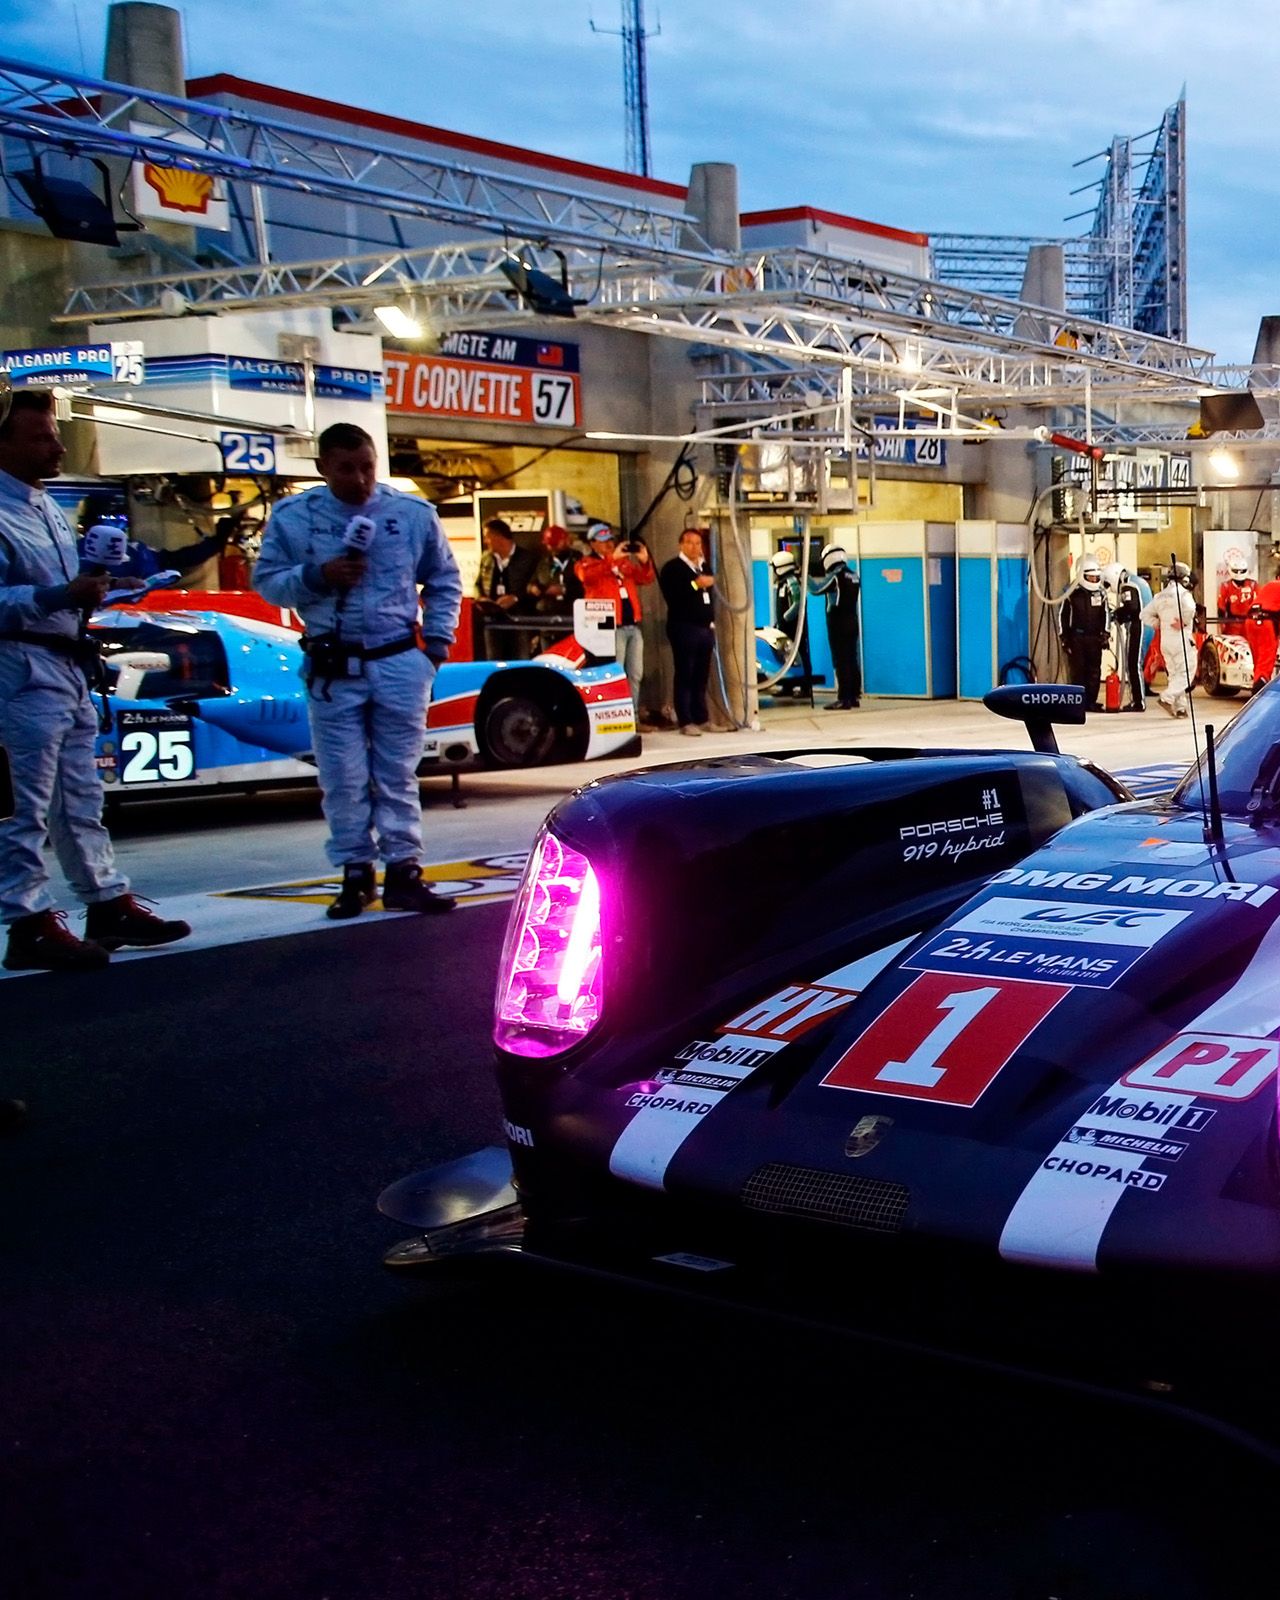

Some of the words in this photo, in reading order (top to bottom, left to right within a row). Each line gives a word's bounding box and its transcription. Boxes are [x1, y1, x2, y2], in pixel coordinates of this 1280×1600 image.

[8, 352, 72, 369] ALGARVE
[77, 349, 110, 364] PRO
[443, 333, 489, 358] MGTE
[491, 338, 517, 361] AM
[27, 375, 60, 385] RACING
[63, 373, 89, 383] TEAM
[115, 355, 143, 385] 25
[331, 370, 369, 384] PRO
[413, 364, 523, 416] CORVETTE
[536, 379, 571, 419] 57
[222, 433, 275, 472] 25
[1021, 693, 1083, 705] CHOPARD
[594, 709, 632, 720] NISSAN
[121, 730, 194, 783] 25
[982, 788, 1001, 810] #1
[900, 813, 1004, 840] PORSCHE
[903, 842, 938, 862] 919
[940, 831, 1005, 863] hybrid
[981, 868, 1112, 889] DMG
[1106, 876, 1279, 908] MORI
[1021, 907, 1165, 928] WEC
[988, 949, 1032, 964] LE
[1025, 953, 1119, 972] MANS
[723, 985, 858, 1035] HY
[874, 986, 1002, 1088] 1
[676, 1042, 748, 1066] Mobil
[1152, 1041, 1272, 1087] P1
[676, 1073, 737, 1088] MICHELIN
[627, 1094, 713, 1115] CHOPARD
[1086, 1095, 1184, 1126] Mobil
[1098, 1134, 1184, 1156] MICHELIN
[1042, 1157, 1164, 1191] CHOPARD
